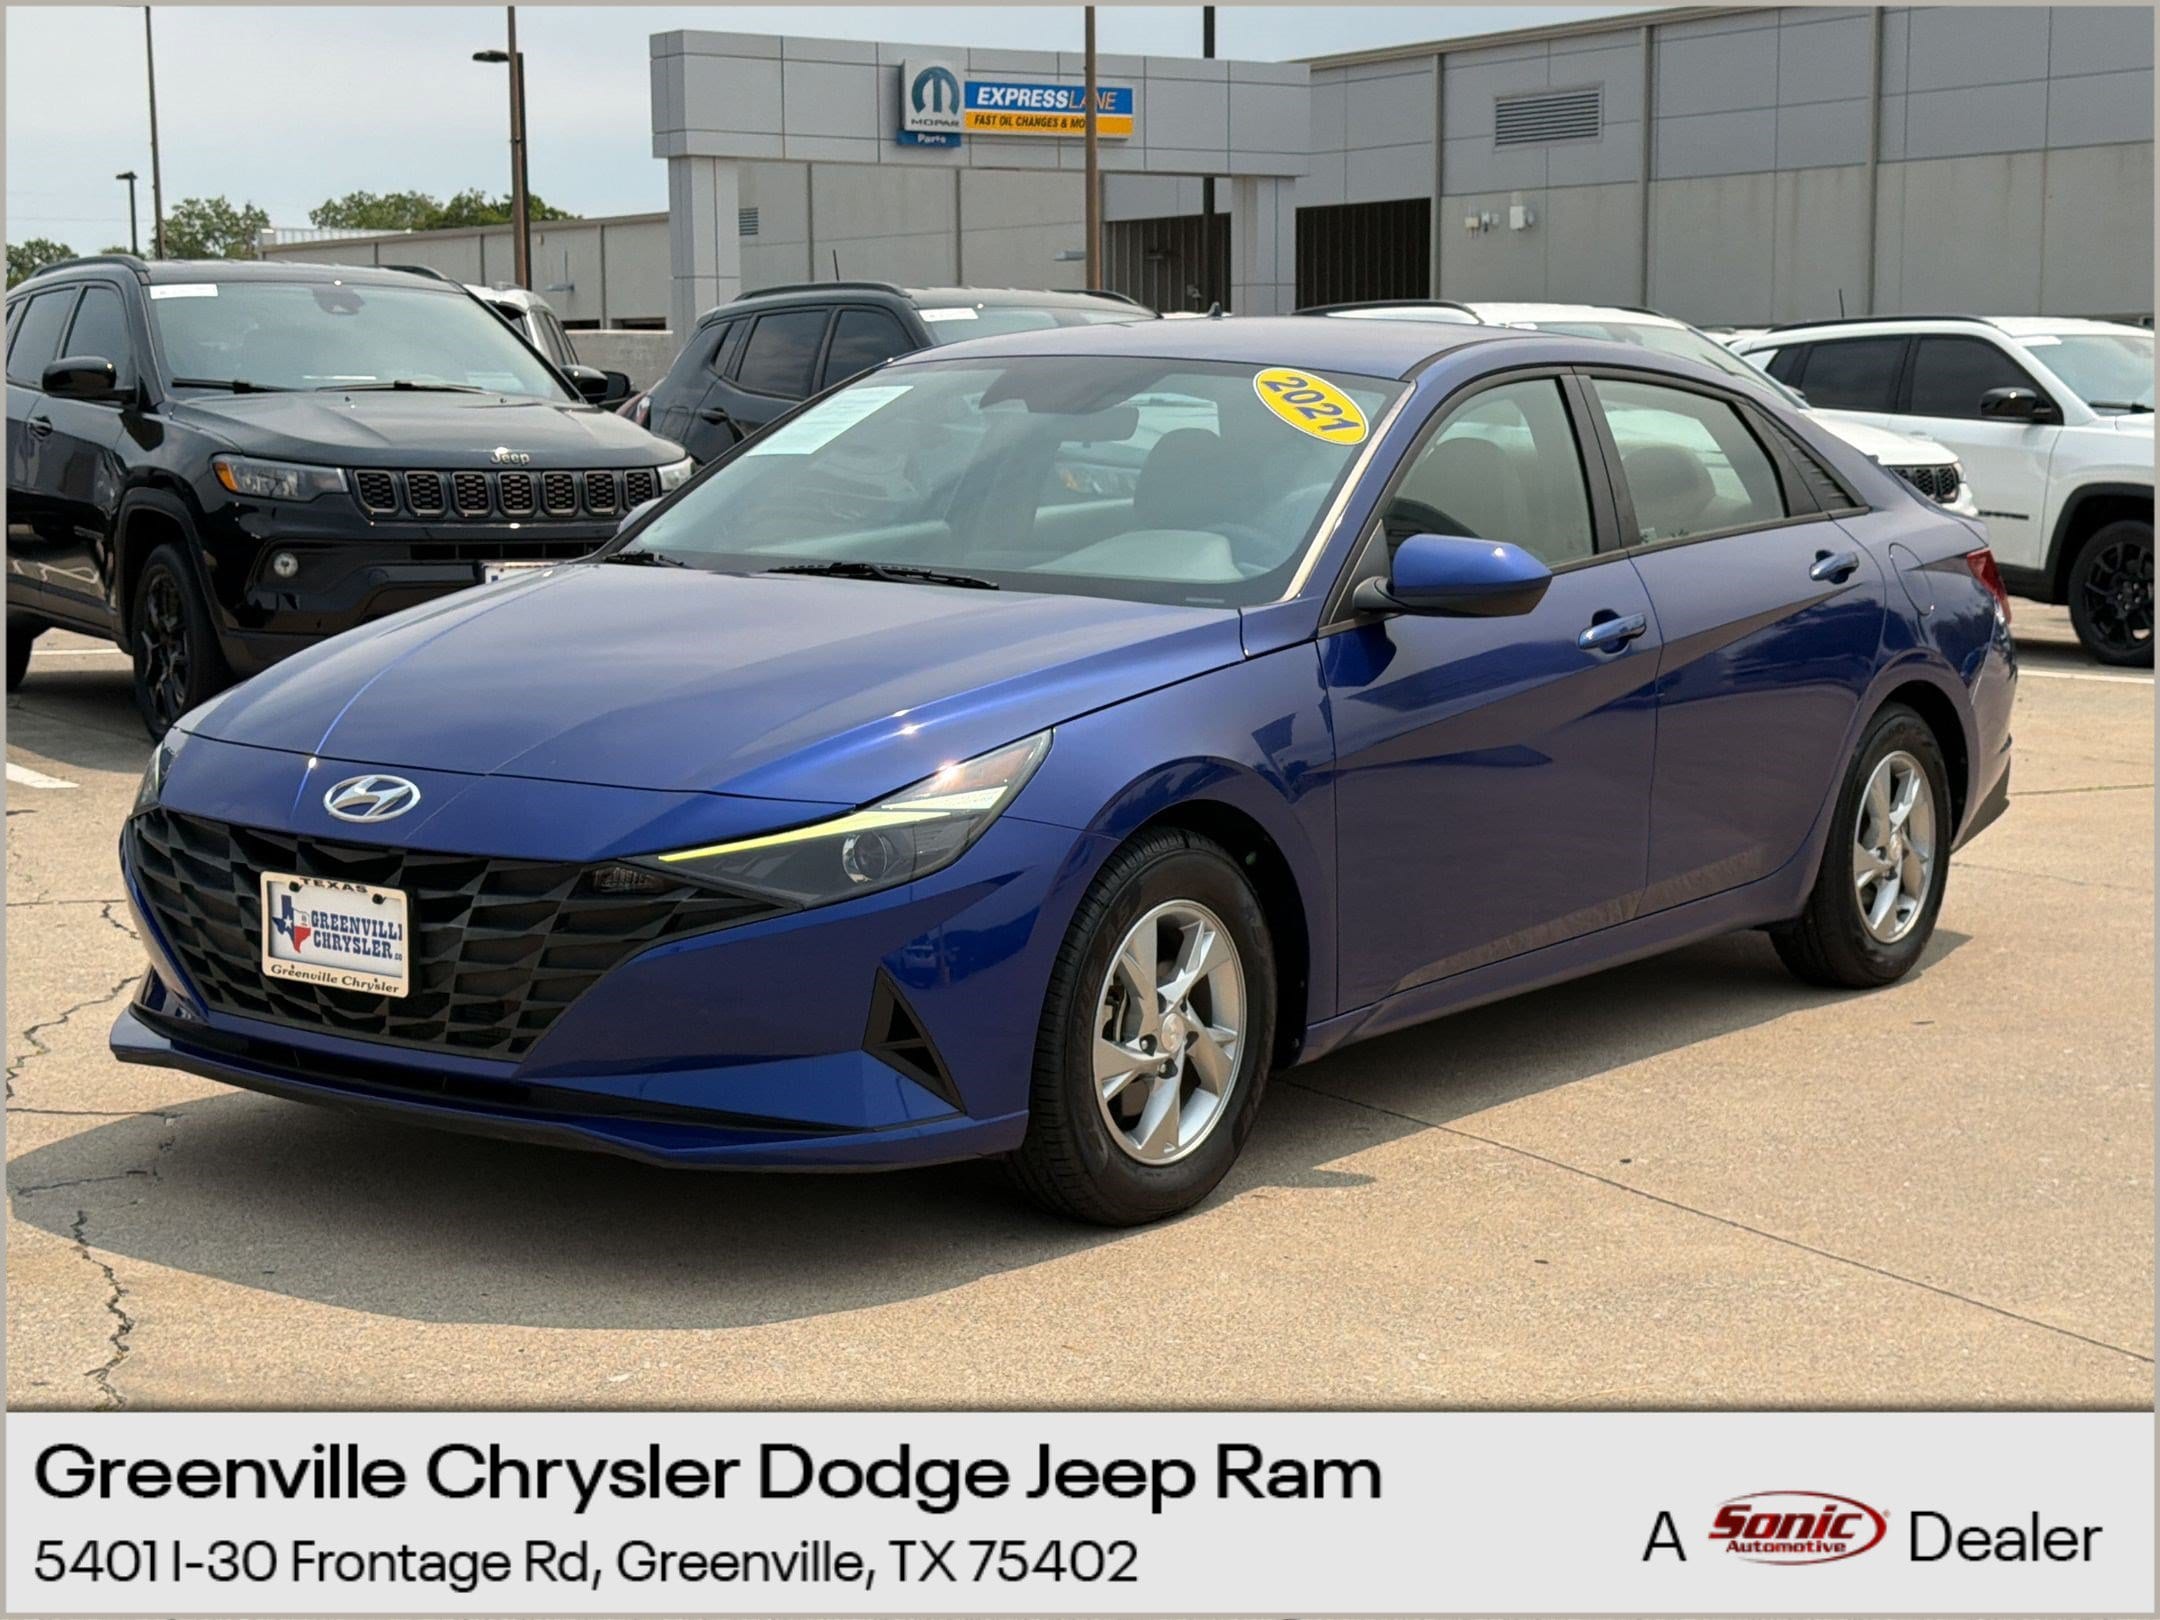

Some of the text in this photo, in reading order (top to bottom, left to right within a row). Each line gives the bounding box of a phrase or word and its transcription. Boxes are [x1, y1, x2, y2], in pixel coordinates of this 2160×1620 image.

[911, 118, 960, 127] MOPAR
[974, 115, 996, 126] FAST
[999, 115, 1014, 126] OIL
[1015, 116, 1059, 128] CHANGES
[1060, 118, 1069, 128] &
[917, 134, 946, 144] Parts
[1260, 376, 1361, 431] 2021
[491, 450, 530, 465] Jeep
[300, 878, 368, 893] TEXAS
[271, 964, 399, 994] Greenville Chrysler
